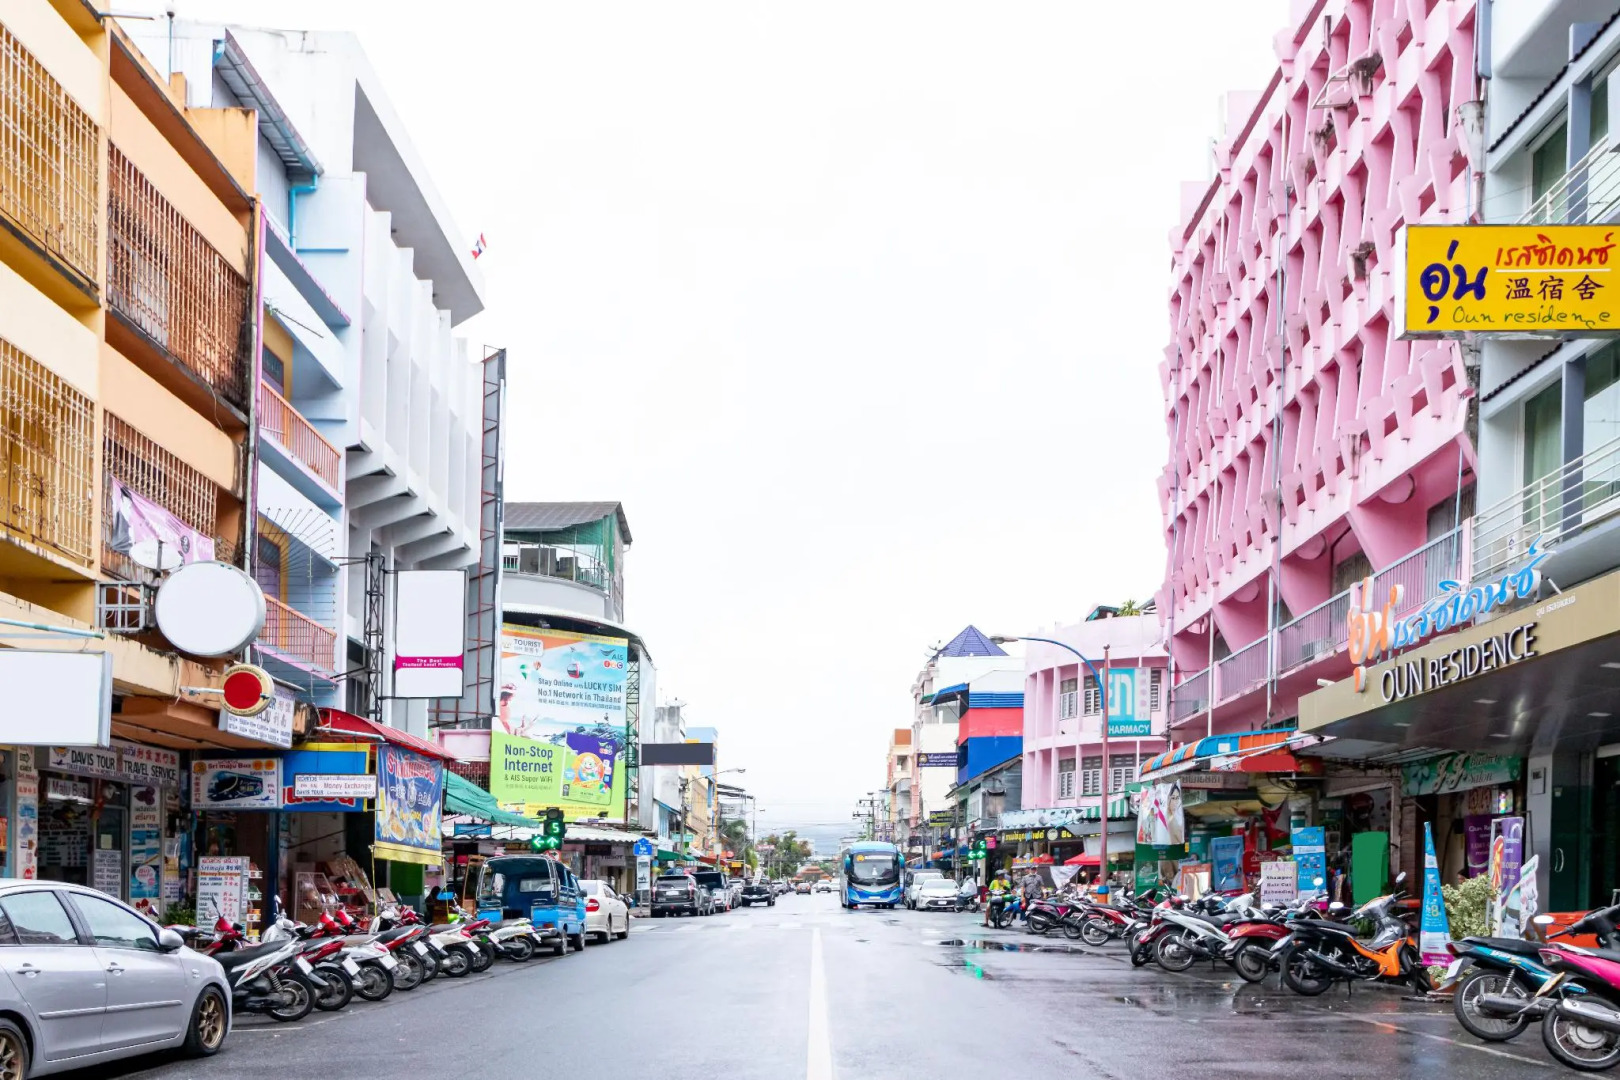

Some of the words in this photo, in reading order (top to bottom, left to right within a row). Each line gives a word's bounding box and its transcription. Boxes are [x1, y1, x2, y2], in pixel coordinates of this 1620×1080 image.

[1420, 239, 1488, 324] อุ่น
[1453, 306, 1494, 323] Oun
[514, 639, 541, 648] TOURIST
[1381, 658, 1425, 703] OUN
[1429, 622, 1537, 690] RESIDENCE
[538, 678, 552, 687] Stay
[553, 680, 573, 688] Online
[584, 681, 607, 692] LUCKY
[608, 684, 622, 693] SIM
[538, 688, 552, 698] No.1
[553, 690, 582, 700] Network
[584, 692, 591, 700] in
[594, 694, 622, 704] Thailand
[1108, 725, 1150, 735] HARMACY
[504, 744, 553, 760] Non-Stop
[72, 750, 94, 766] DAVIS
[96, 755, 115, 770] TOUR
[124, 760, 148, 776] TRAVEL
[151, 765, 176, 780] SERVICE
[504, 758, 553, 773] Internet
[552, 822, 560, 834] 5
[979, 840, 985, 848] 5
